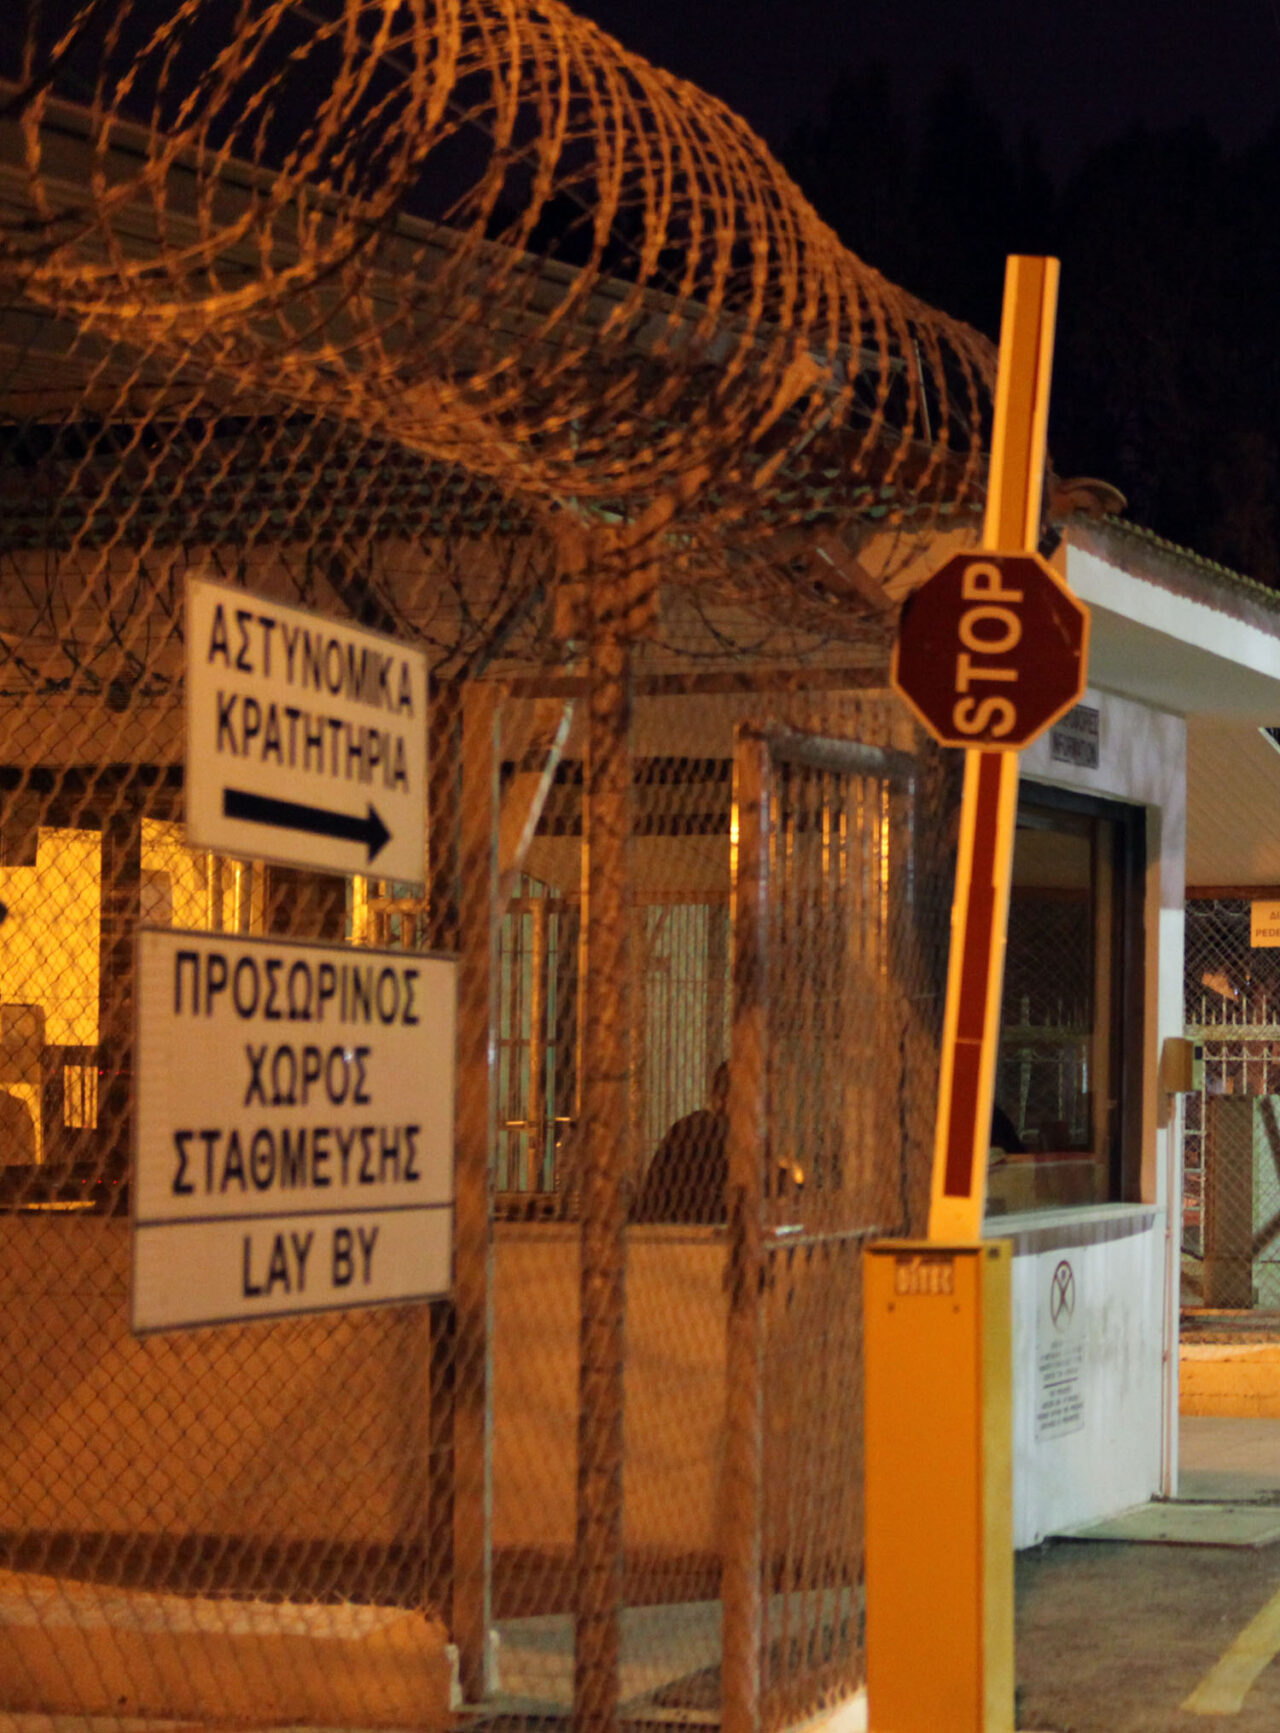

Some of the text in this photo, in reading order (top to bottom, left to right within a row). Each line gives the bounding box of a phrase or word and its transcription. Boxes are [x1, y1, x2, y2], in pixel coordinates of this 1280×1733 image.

[206, 603, 414, 719] ΑΣΤΥΝΟΜΙΚΑ
[952, 562, 1024, 737] STOP
[215, 690, 410, 794] ΚΡΑΤΗΤΗΡΙΑ
[174, 949, 421, 1027] ΠΡΟΣΩΡΙΝΟΣ
[244, 1042, 372, 1109] ΧΩΡΟΣ
[172, 1123, 421, 1197] ΣΤΑΘΜΕΥΣΗΣ
[243, 1225, 379, 1298] LAY BY
